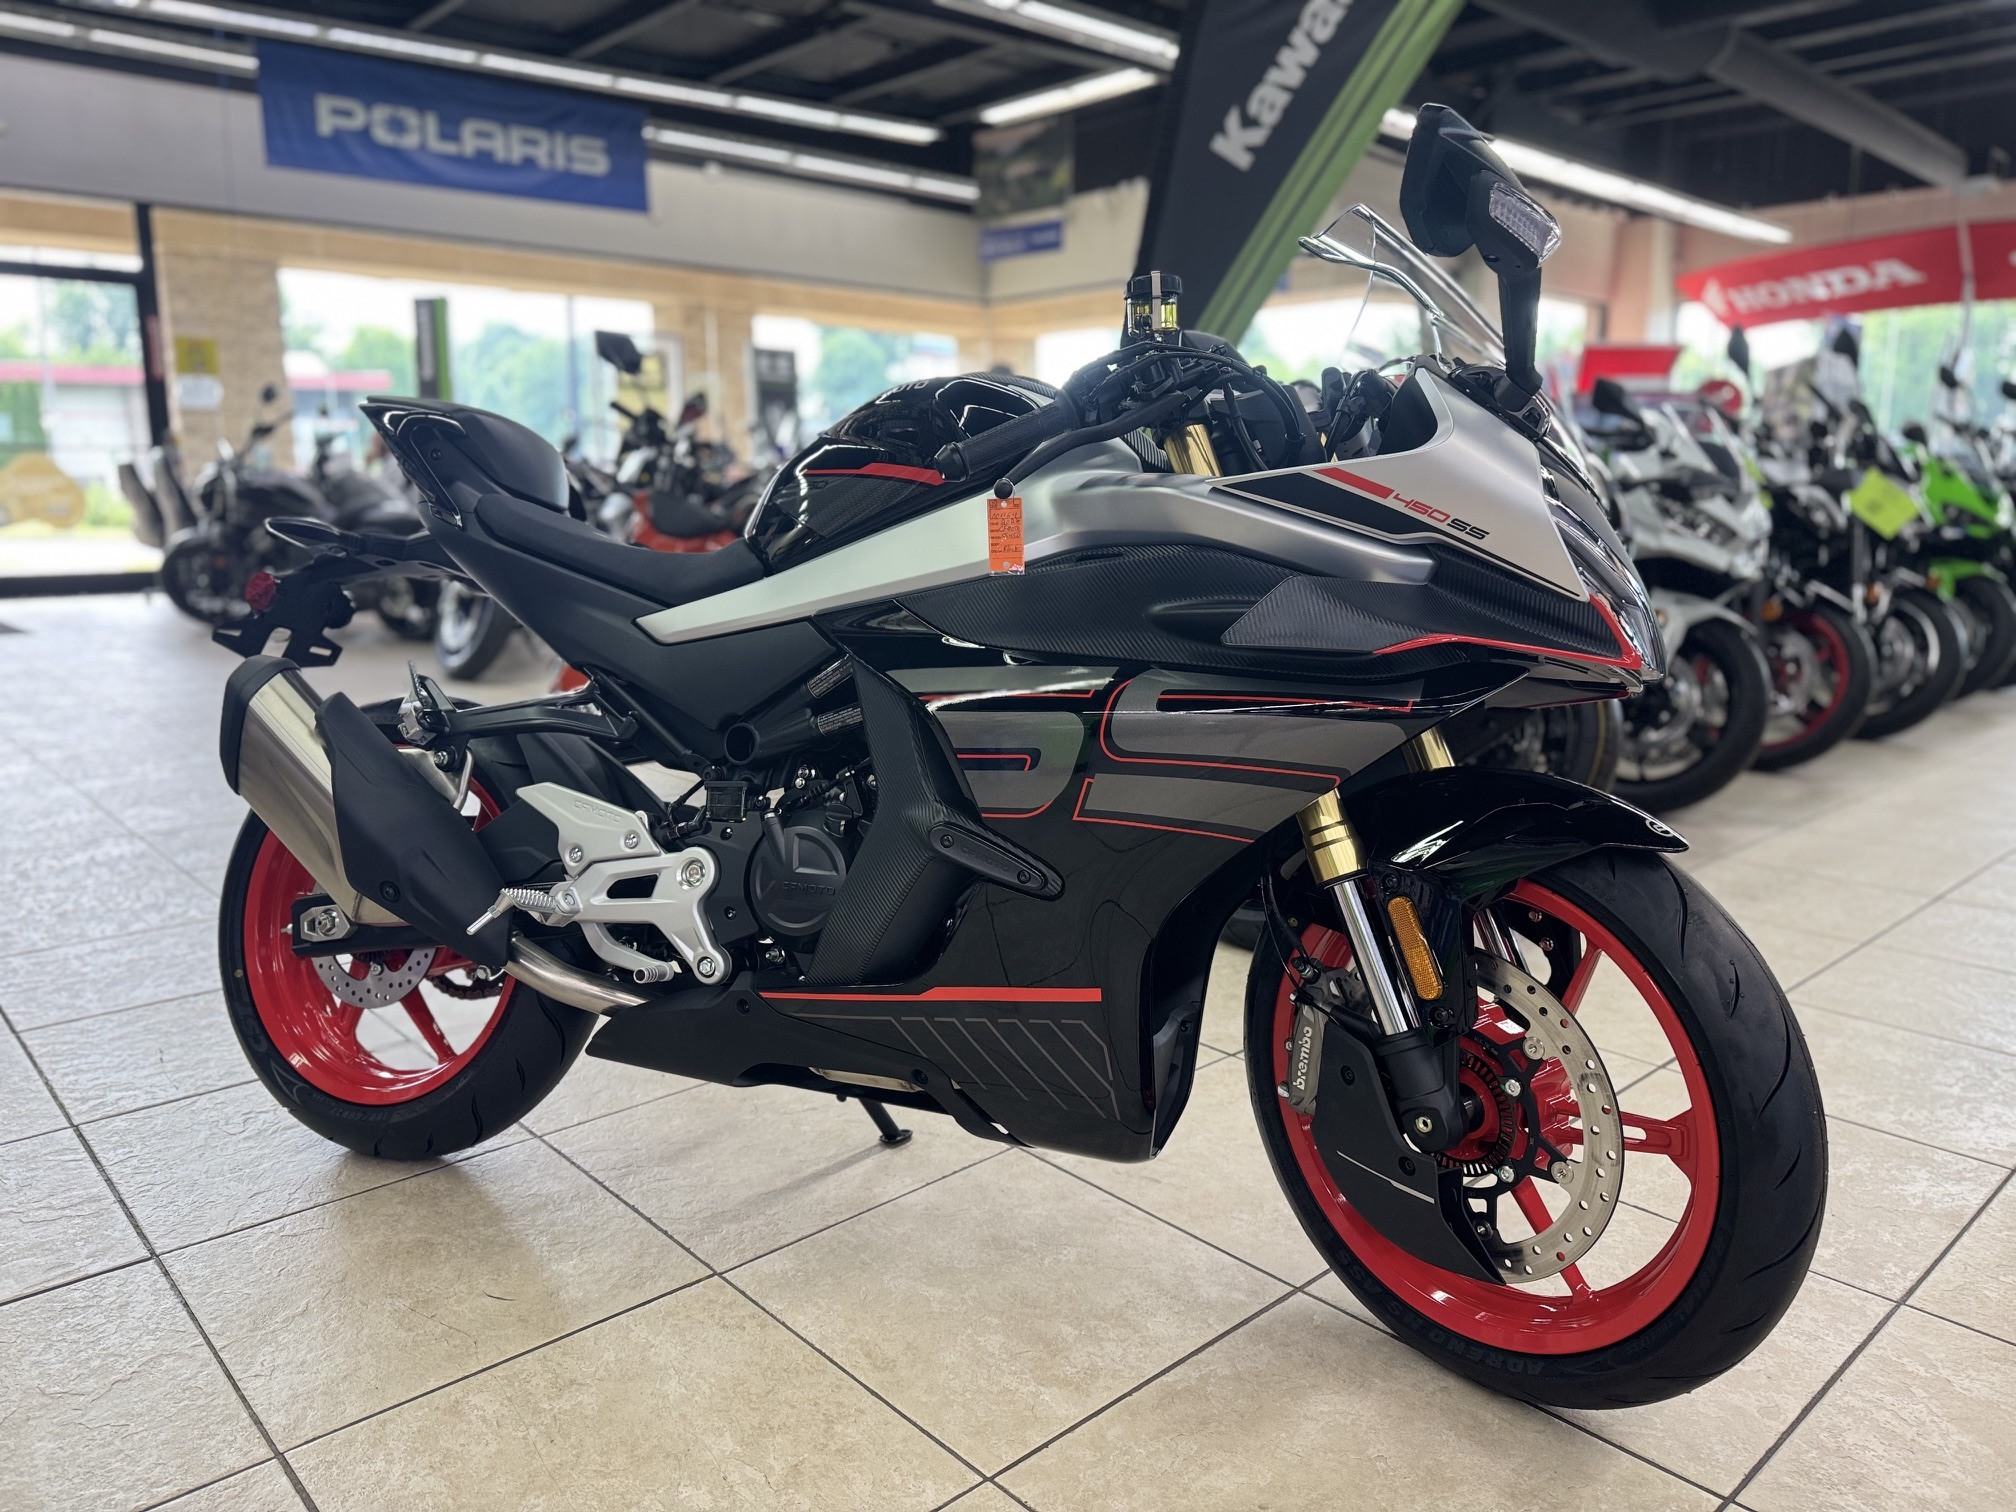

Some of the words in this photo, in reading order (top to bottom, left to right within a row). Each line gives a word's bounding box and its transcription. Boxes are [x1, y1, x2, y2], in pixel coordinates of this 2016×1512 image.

[1209, 0, 1353, 171] Kawa
[314, 93, 611, 178] POLARIS
[1727, 257, 1927, 314] HONDA
[1292, 1025, 1314, 1091] brembo
[1428, 1331, 1545, 1375] ADRENO
